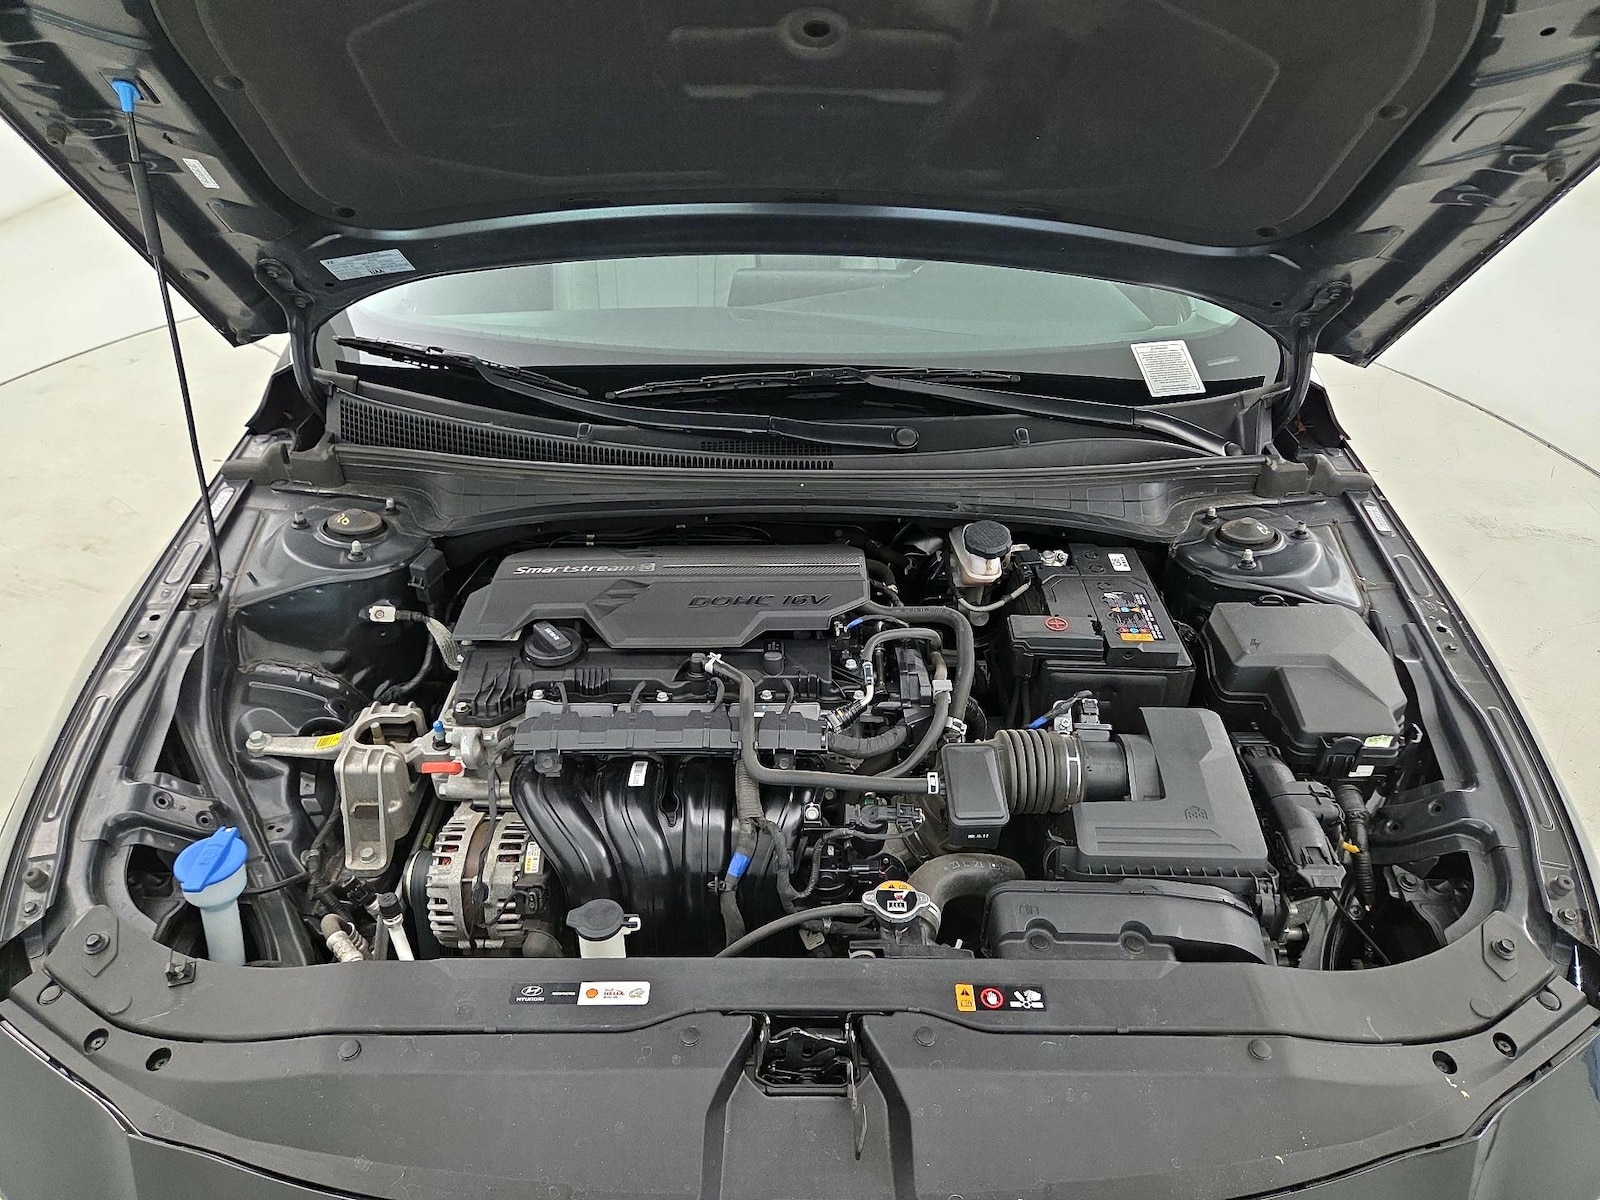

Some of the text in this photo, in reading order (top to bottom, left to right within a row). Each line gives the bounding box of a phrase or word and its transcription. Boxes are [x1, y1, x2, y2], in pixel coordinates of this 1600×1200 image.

[512, 564, 635, 575] Smartstream
[687, 592, 833, 609] DOHC 16V
